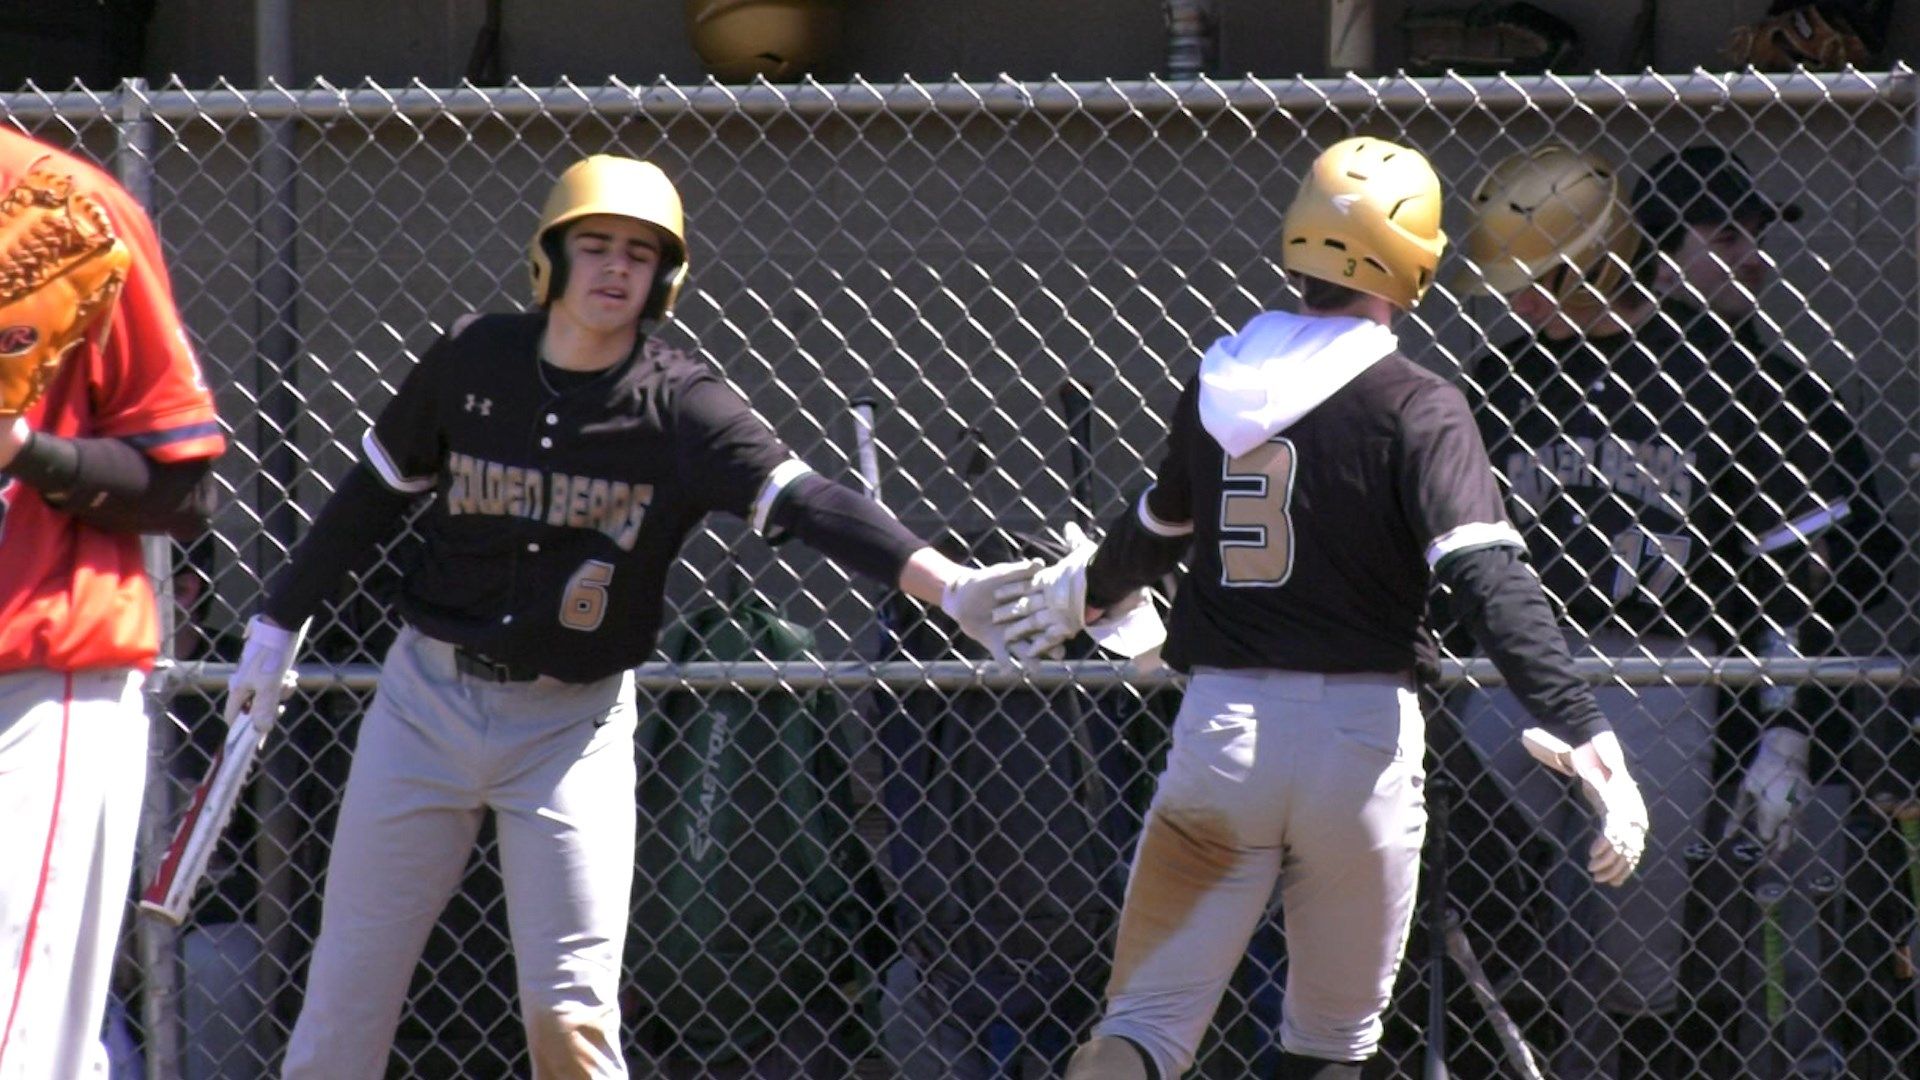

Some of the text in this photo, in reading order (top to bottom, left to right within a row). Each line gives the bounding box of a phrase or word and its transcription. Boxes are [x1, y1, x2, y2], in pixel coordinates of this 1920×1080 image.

[1343, 257, 1357, 277] 3
[547, 471, 654, 551] BEARS
[1219, 436, 1298, 588] 3
[558, 558, 615, 632] 6
[1613, 526, 1691, 603] 17
